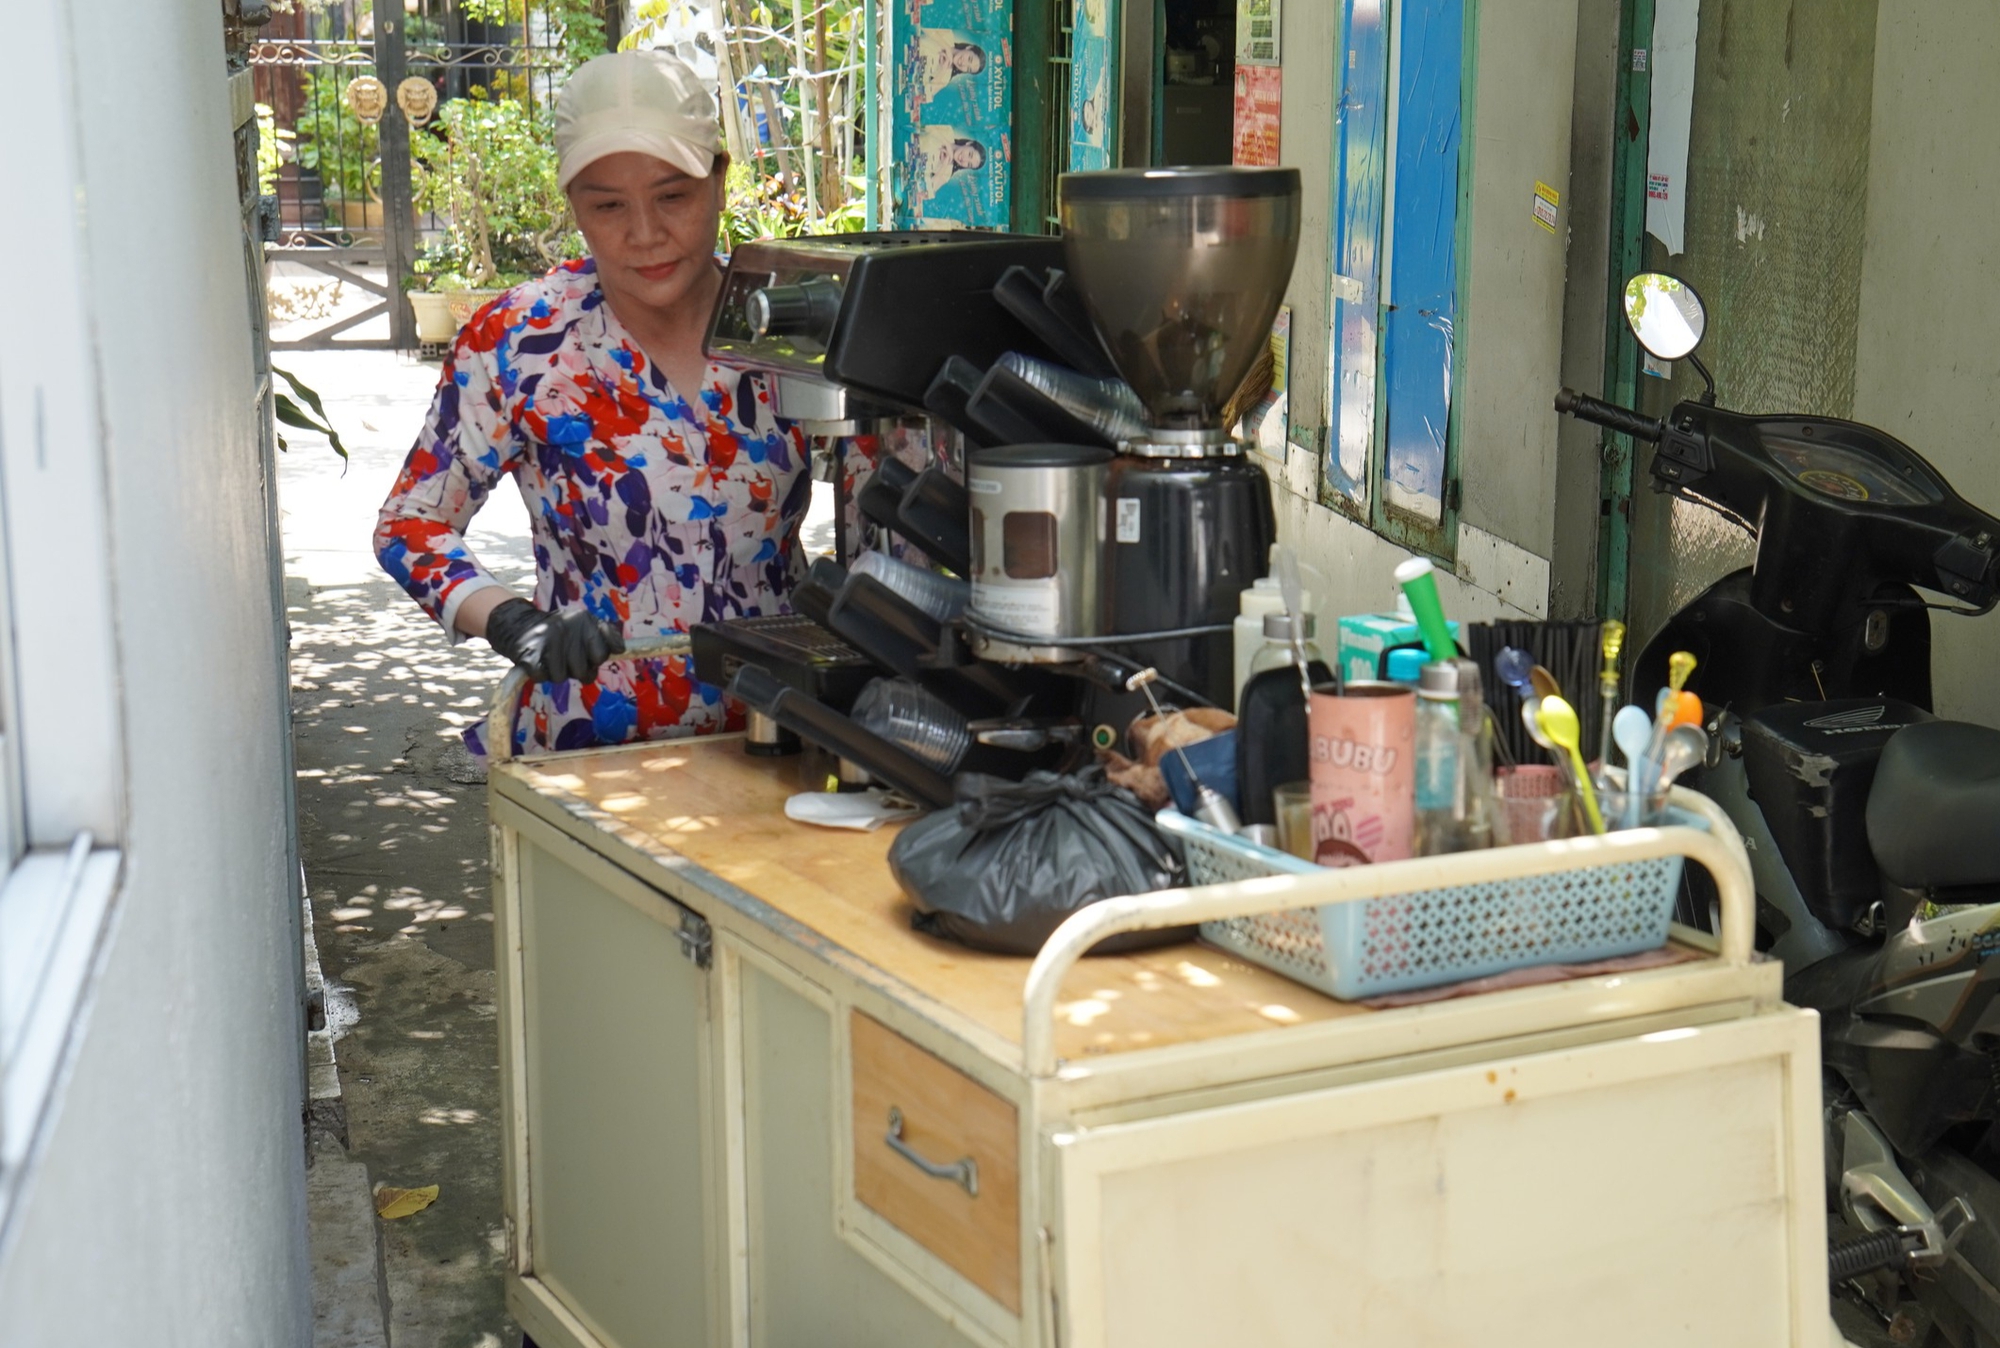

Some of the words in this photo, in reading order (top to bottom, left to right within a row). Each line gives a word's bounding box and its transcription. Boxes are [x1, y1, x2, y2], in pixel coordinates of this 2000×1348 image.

[994, 65, 1003, 110] XYLITOL
[994, 161, 1003, 205] XYLITOL
[1310, 734, 1397, 777] BUBU
